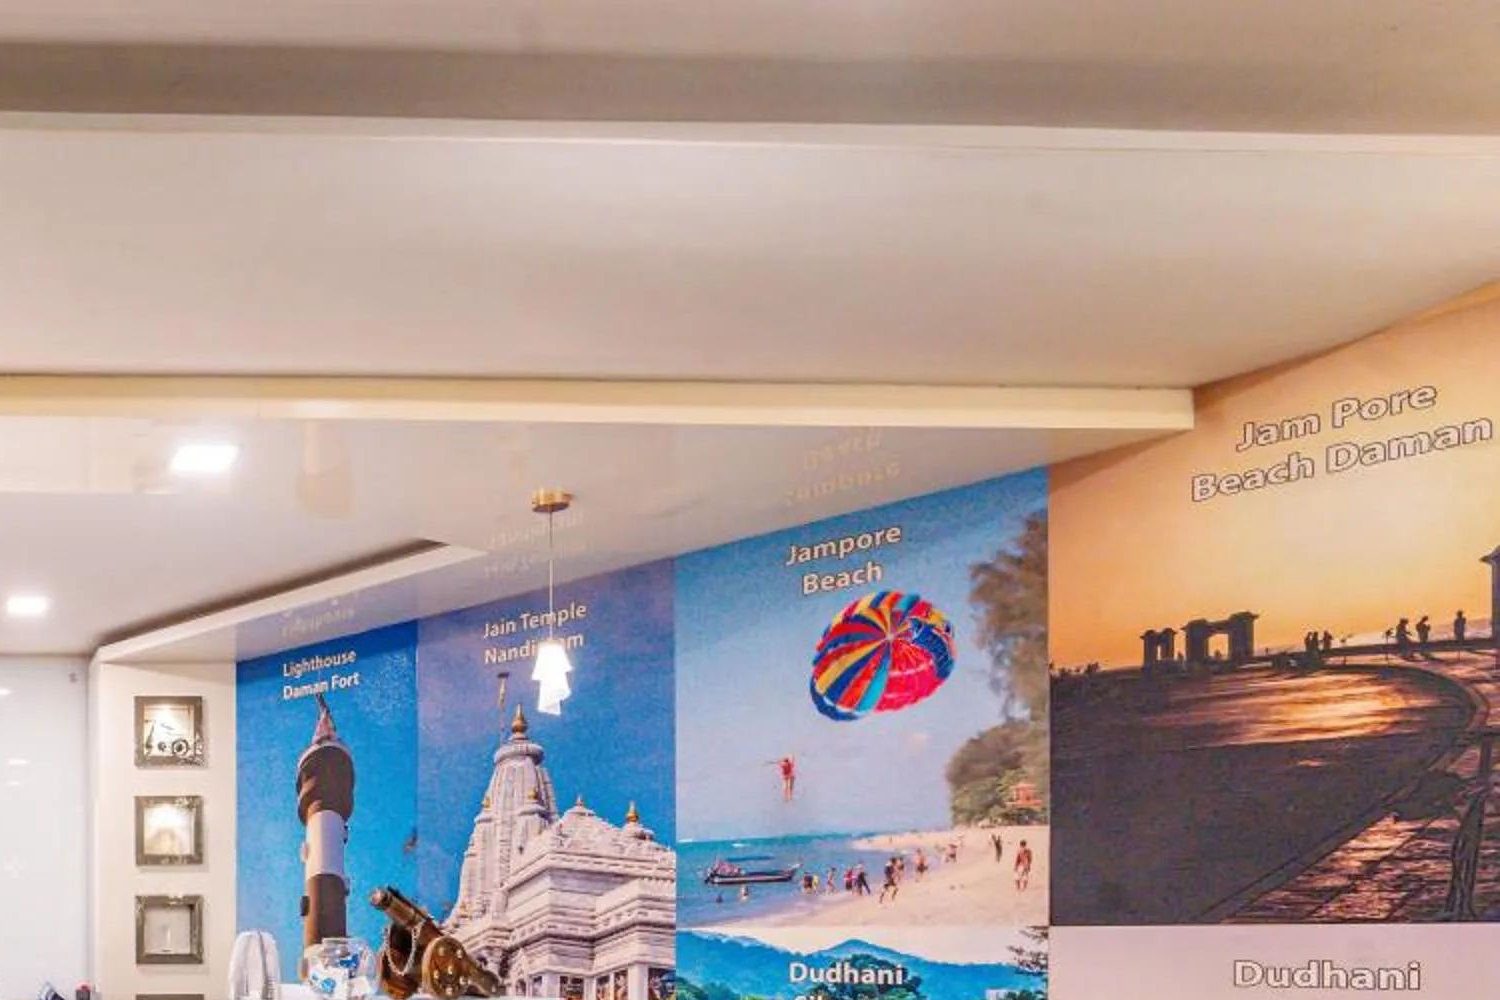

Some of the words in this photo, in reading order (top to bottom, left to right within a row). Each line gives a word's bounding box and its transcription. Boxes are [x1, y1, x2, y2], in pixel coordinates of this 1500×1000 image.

[1236, 413, 1320, 452] Jam
[1332, 386, 1437, 429] Pore
[1192, 451, 1315, 502] Beach
[1326, 417, 1493, 474] Daman
[785, 526, 901, 567] Jampore
[803, 561, 883, 596] Beach
[483, 618, 517, 640] Jain
[520, 602, 587, 631] Temple
[283, 650, 357, 679] Lighthouse
[484, 632, 585, 665] Nandim
[283, 681, 329, 700] Daman
[331, 671, 360, 690] Fort
[789, 962, 903, 985] Dudhani
[1233, 959, 1421, 991] Dudhani
